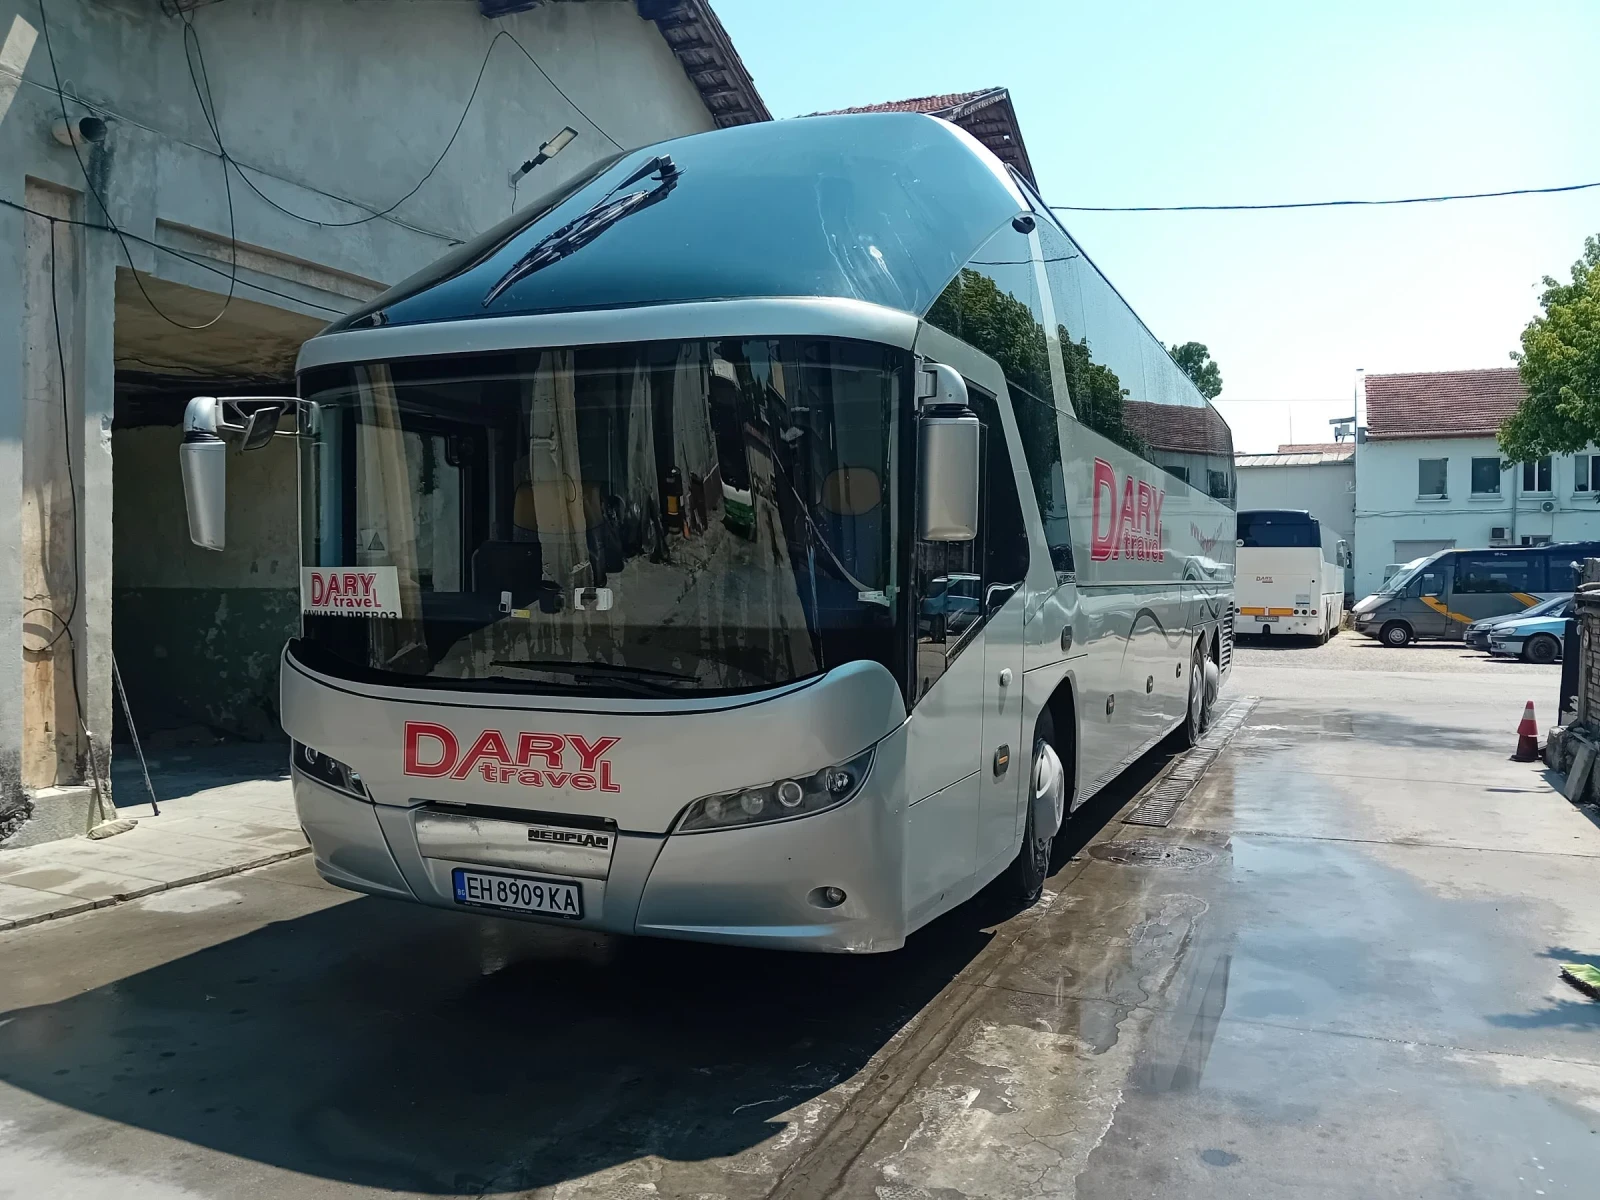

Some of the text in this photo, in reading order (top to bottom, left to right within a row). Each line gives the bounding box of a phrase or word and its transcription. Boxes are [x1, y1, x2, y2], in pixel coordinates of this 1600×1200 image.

[1090, 457, 1165, 562] DARY
[311, 572, 377, 607] DARY
[403, 720, 621, 780] DARY
[528, 829, 609, 848] NEOPLAN
